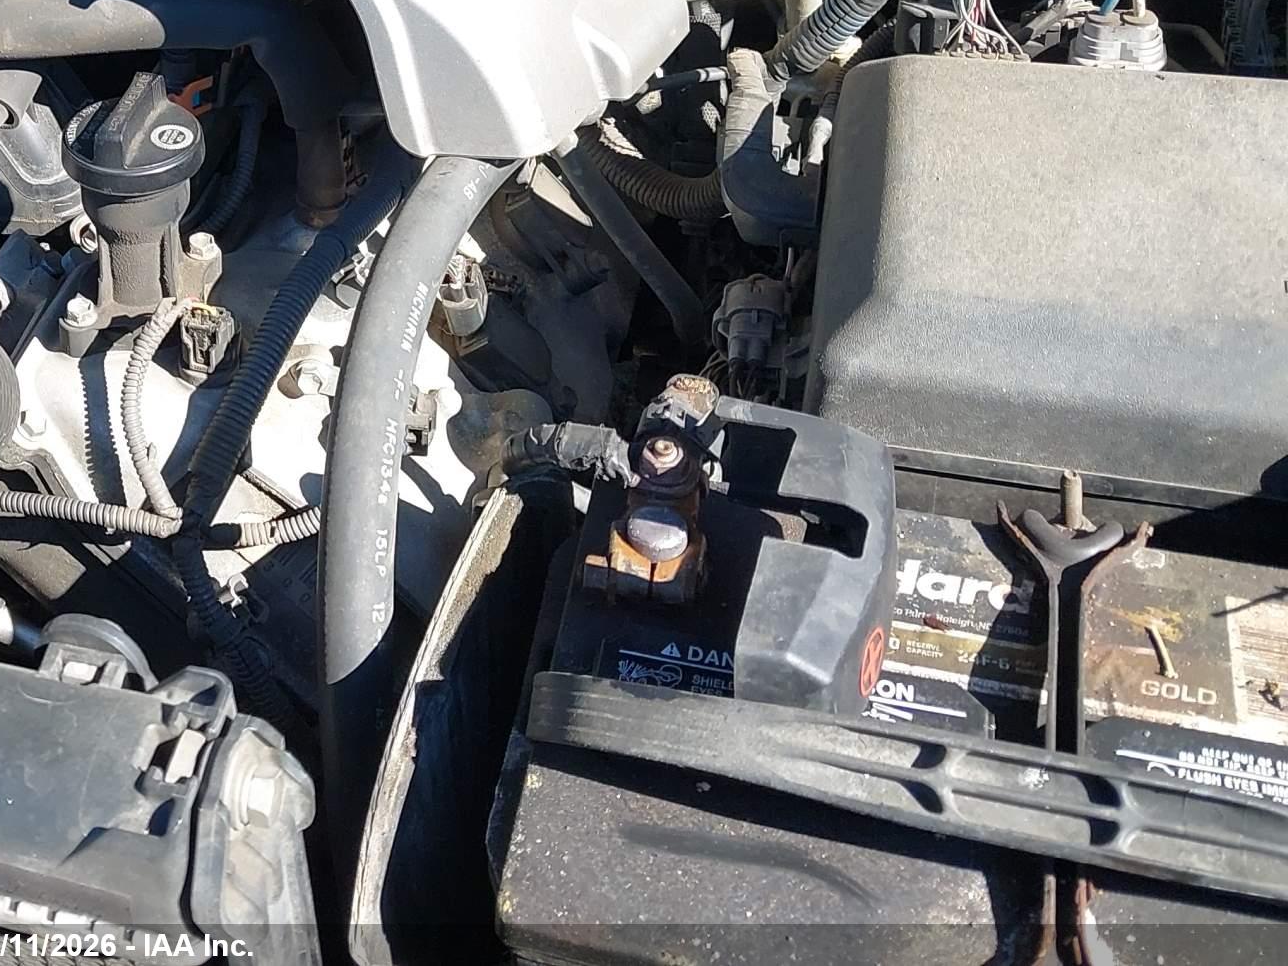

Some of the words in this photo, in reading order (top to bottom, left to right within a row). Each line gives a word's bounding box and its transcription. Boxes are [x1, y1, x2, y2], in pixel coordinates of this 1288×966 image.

[906, 646, 944, 658] CAPACITY
[1140, 680, 1218, 706] GOLD
[1177, 767, 1222, 787] FLUSH
[1224, 775, 1259, 793] EYES
